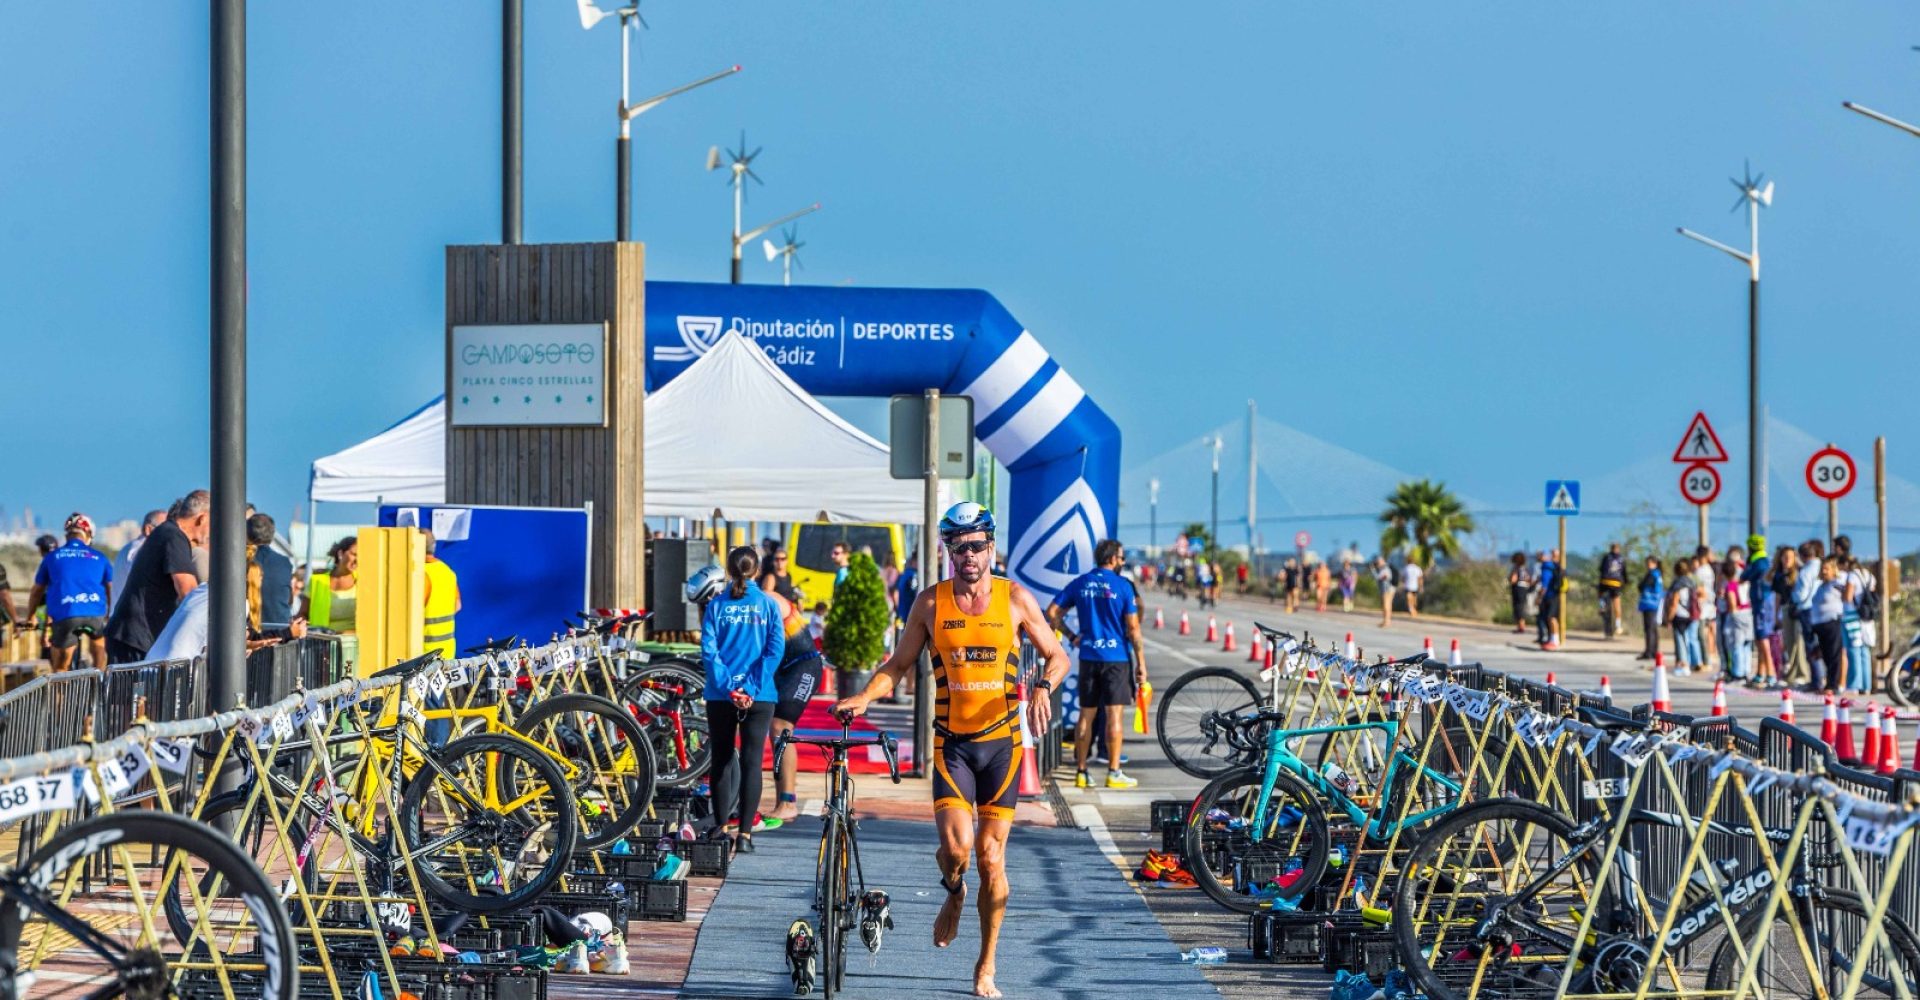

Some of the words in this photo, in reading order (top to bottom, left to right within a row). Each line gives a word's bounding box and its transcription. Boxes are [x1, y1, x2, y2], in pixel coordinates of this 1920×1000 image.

[731, 317, 835, 342] Diputación
[853, 322, 955, 341] DEPORTES
[763, 345, 816, 366] Cádiz
[462, 377, 495, 386] PLAYA
[500, 376, 534, 386] CINCO
[538, 375, 594, 386] ESTRELLAS
[1817, 465, 1846, 483] 30
[1689, 476, 1713, 492] 20
[725, 604, 761, 613] OFICIAL
[534, 656, 548, 670] 24
[295, 704, 311, 721] 51
[241, 717, 256, 736] 56
[1596, 780, 1621, 797] 155
[0, 785, 28, 810] 68
[1735, 826, 1790, 841] cevélo
